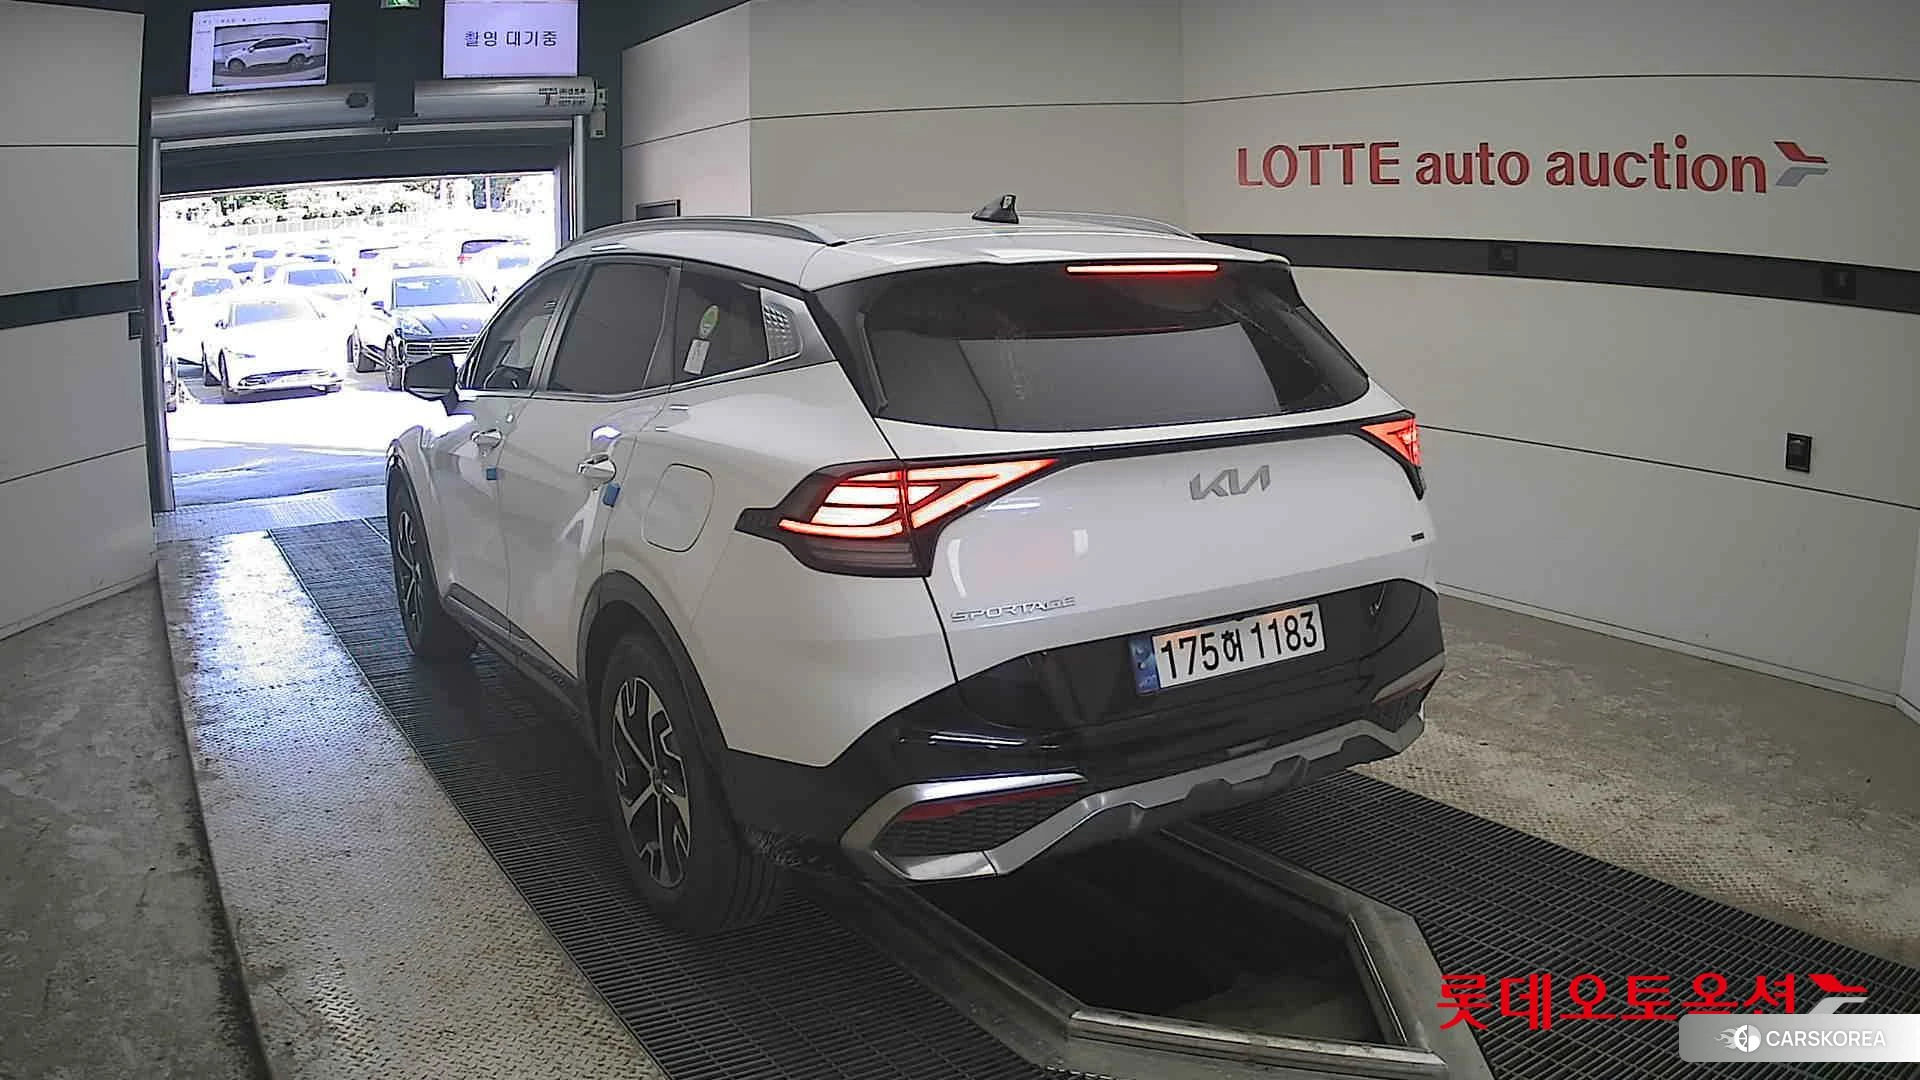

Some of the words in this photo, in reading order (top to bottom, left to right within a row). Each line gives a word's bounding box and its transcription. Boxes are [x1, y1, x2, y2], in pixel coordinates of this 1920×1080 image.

[505, 30, 558, 47] 대기중
[1237, 142, 1399, 188] LOTTE
[1416, 143, 1531, 187] auto
[1546, 135, 1767, 194] auction
[951, 595, 1077, 623] SPORTAGE
[1160, 628, 1245, 679] 175허
[1251, 610, 1318, 659] 1183
